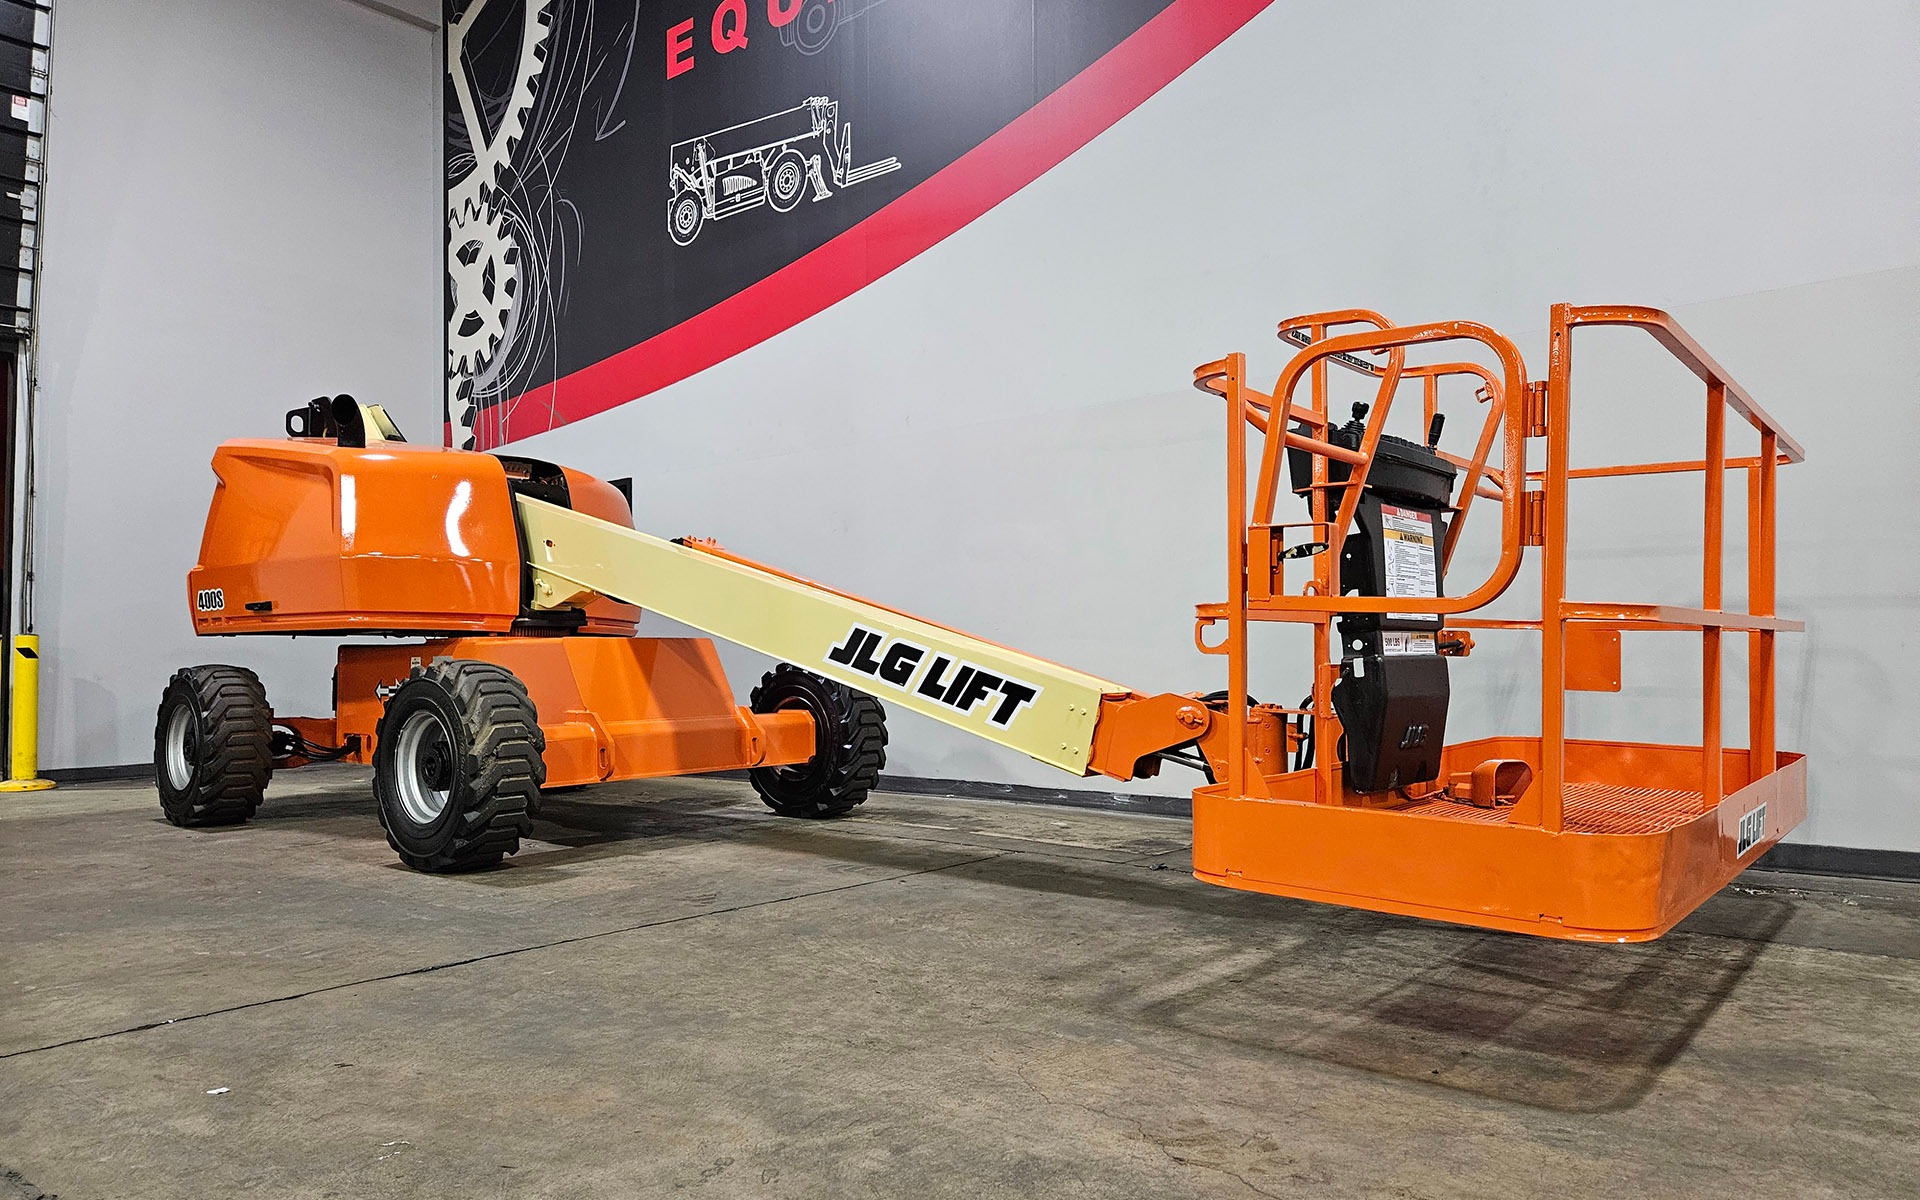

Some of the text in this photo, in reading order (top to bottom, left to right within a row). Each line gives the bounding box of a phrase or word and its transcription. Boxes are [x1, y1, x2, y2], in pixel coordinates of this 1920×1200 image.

[666, 0, 834, 80] EQU
[1400, 508, 1418, 520] DANGER
[1403, 532, 1423, 545] WARNING
[198, 590, 224, 610] 400S
[1393, 637, 1401, 647] LBS
[828, 627, 1037, 725] JLG LIFT
[1738, 805, 1766, 855] JLG LIFT
